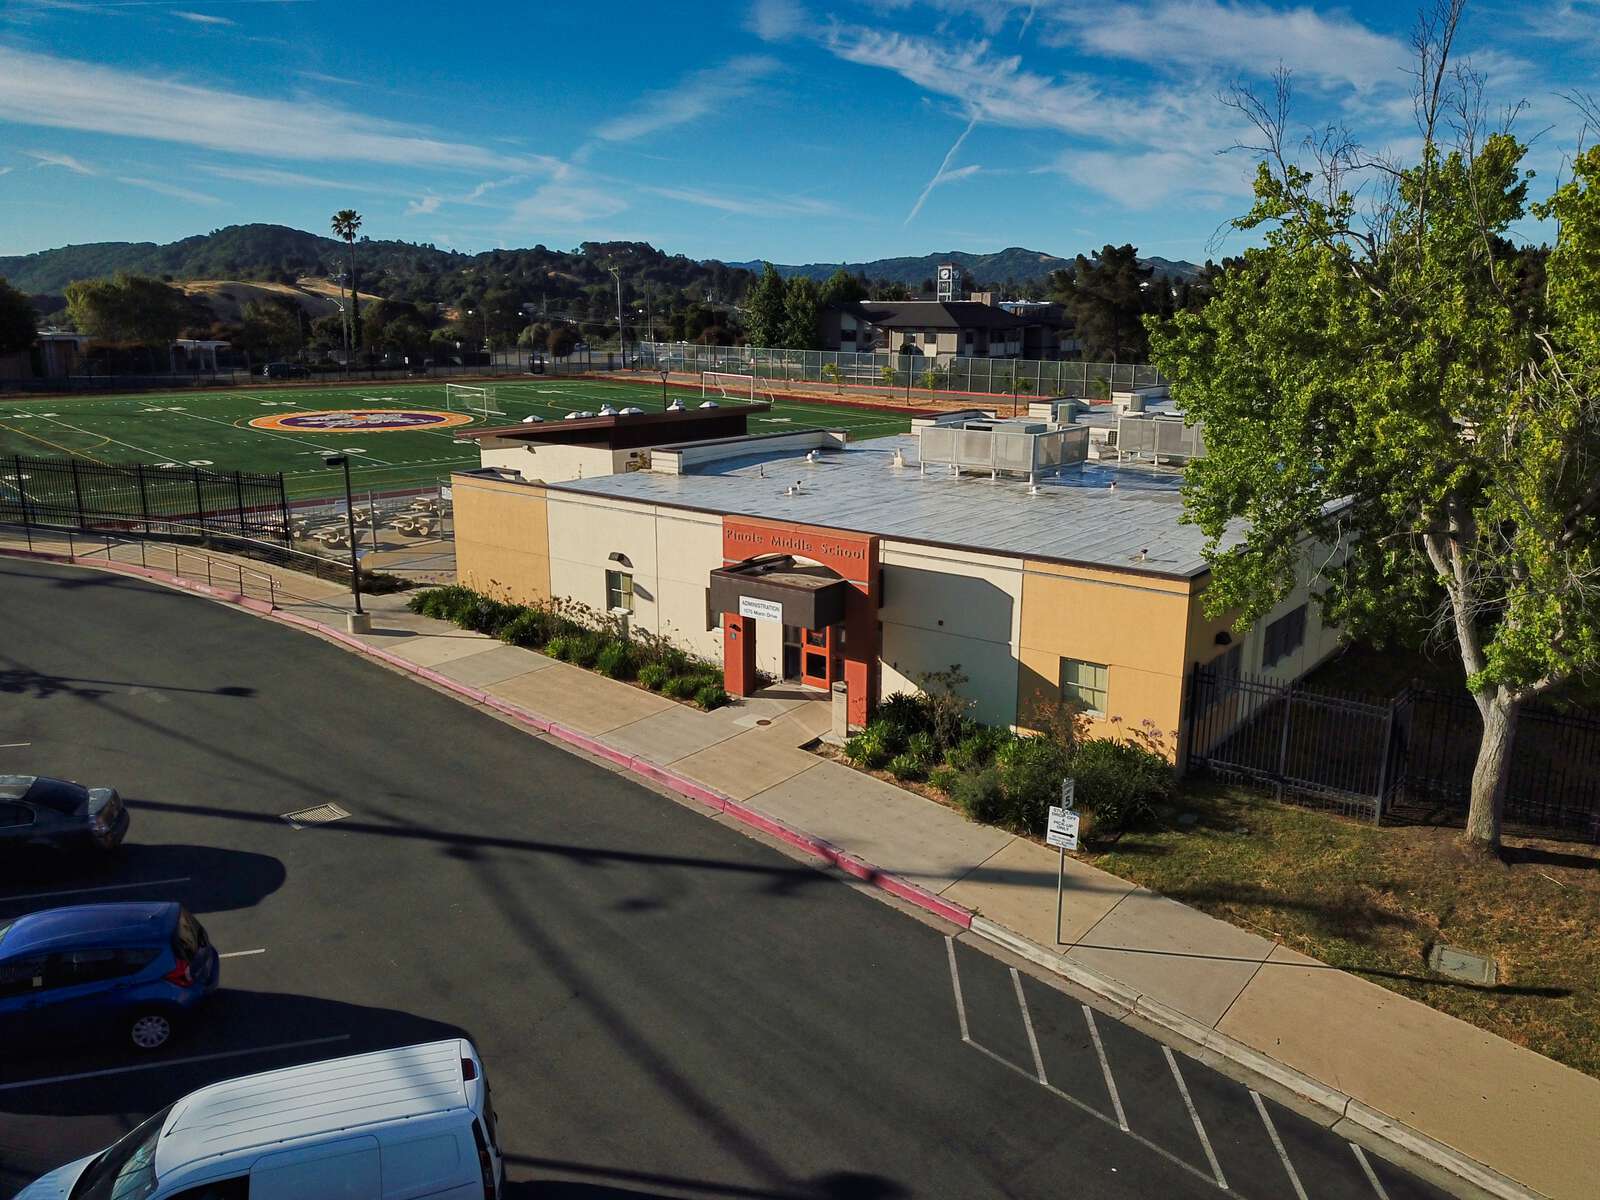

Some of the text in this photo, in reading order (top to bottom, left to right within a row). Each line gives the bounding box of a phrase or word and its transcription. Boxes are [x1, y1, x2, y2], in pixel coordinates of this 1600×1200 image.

[727, 529, 866, 560] Pinole Middle School
[742, 600, 780, 612] ADMINISTRATION
